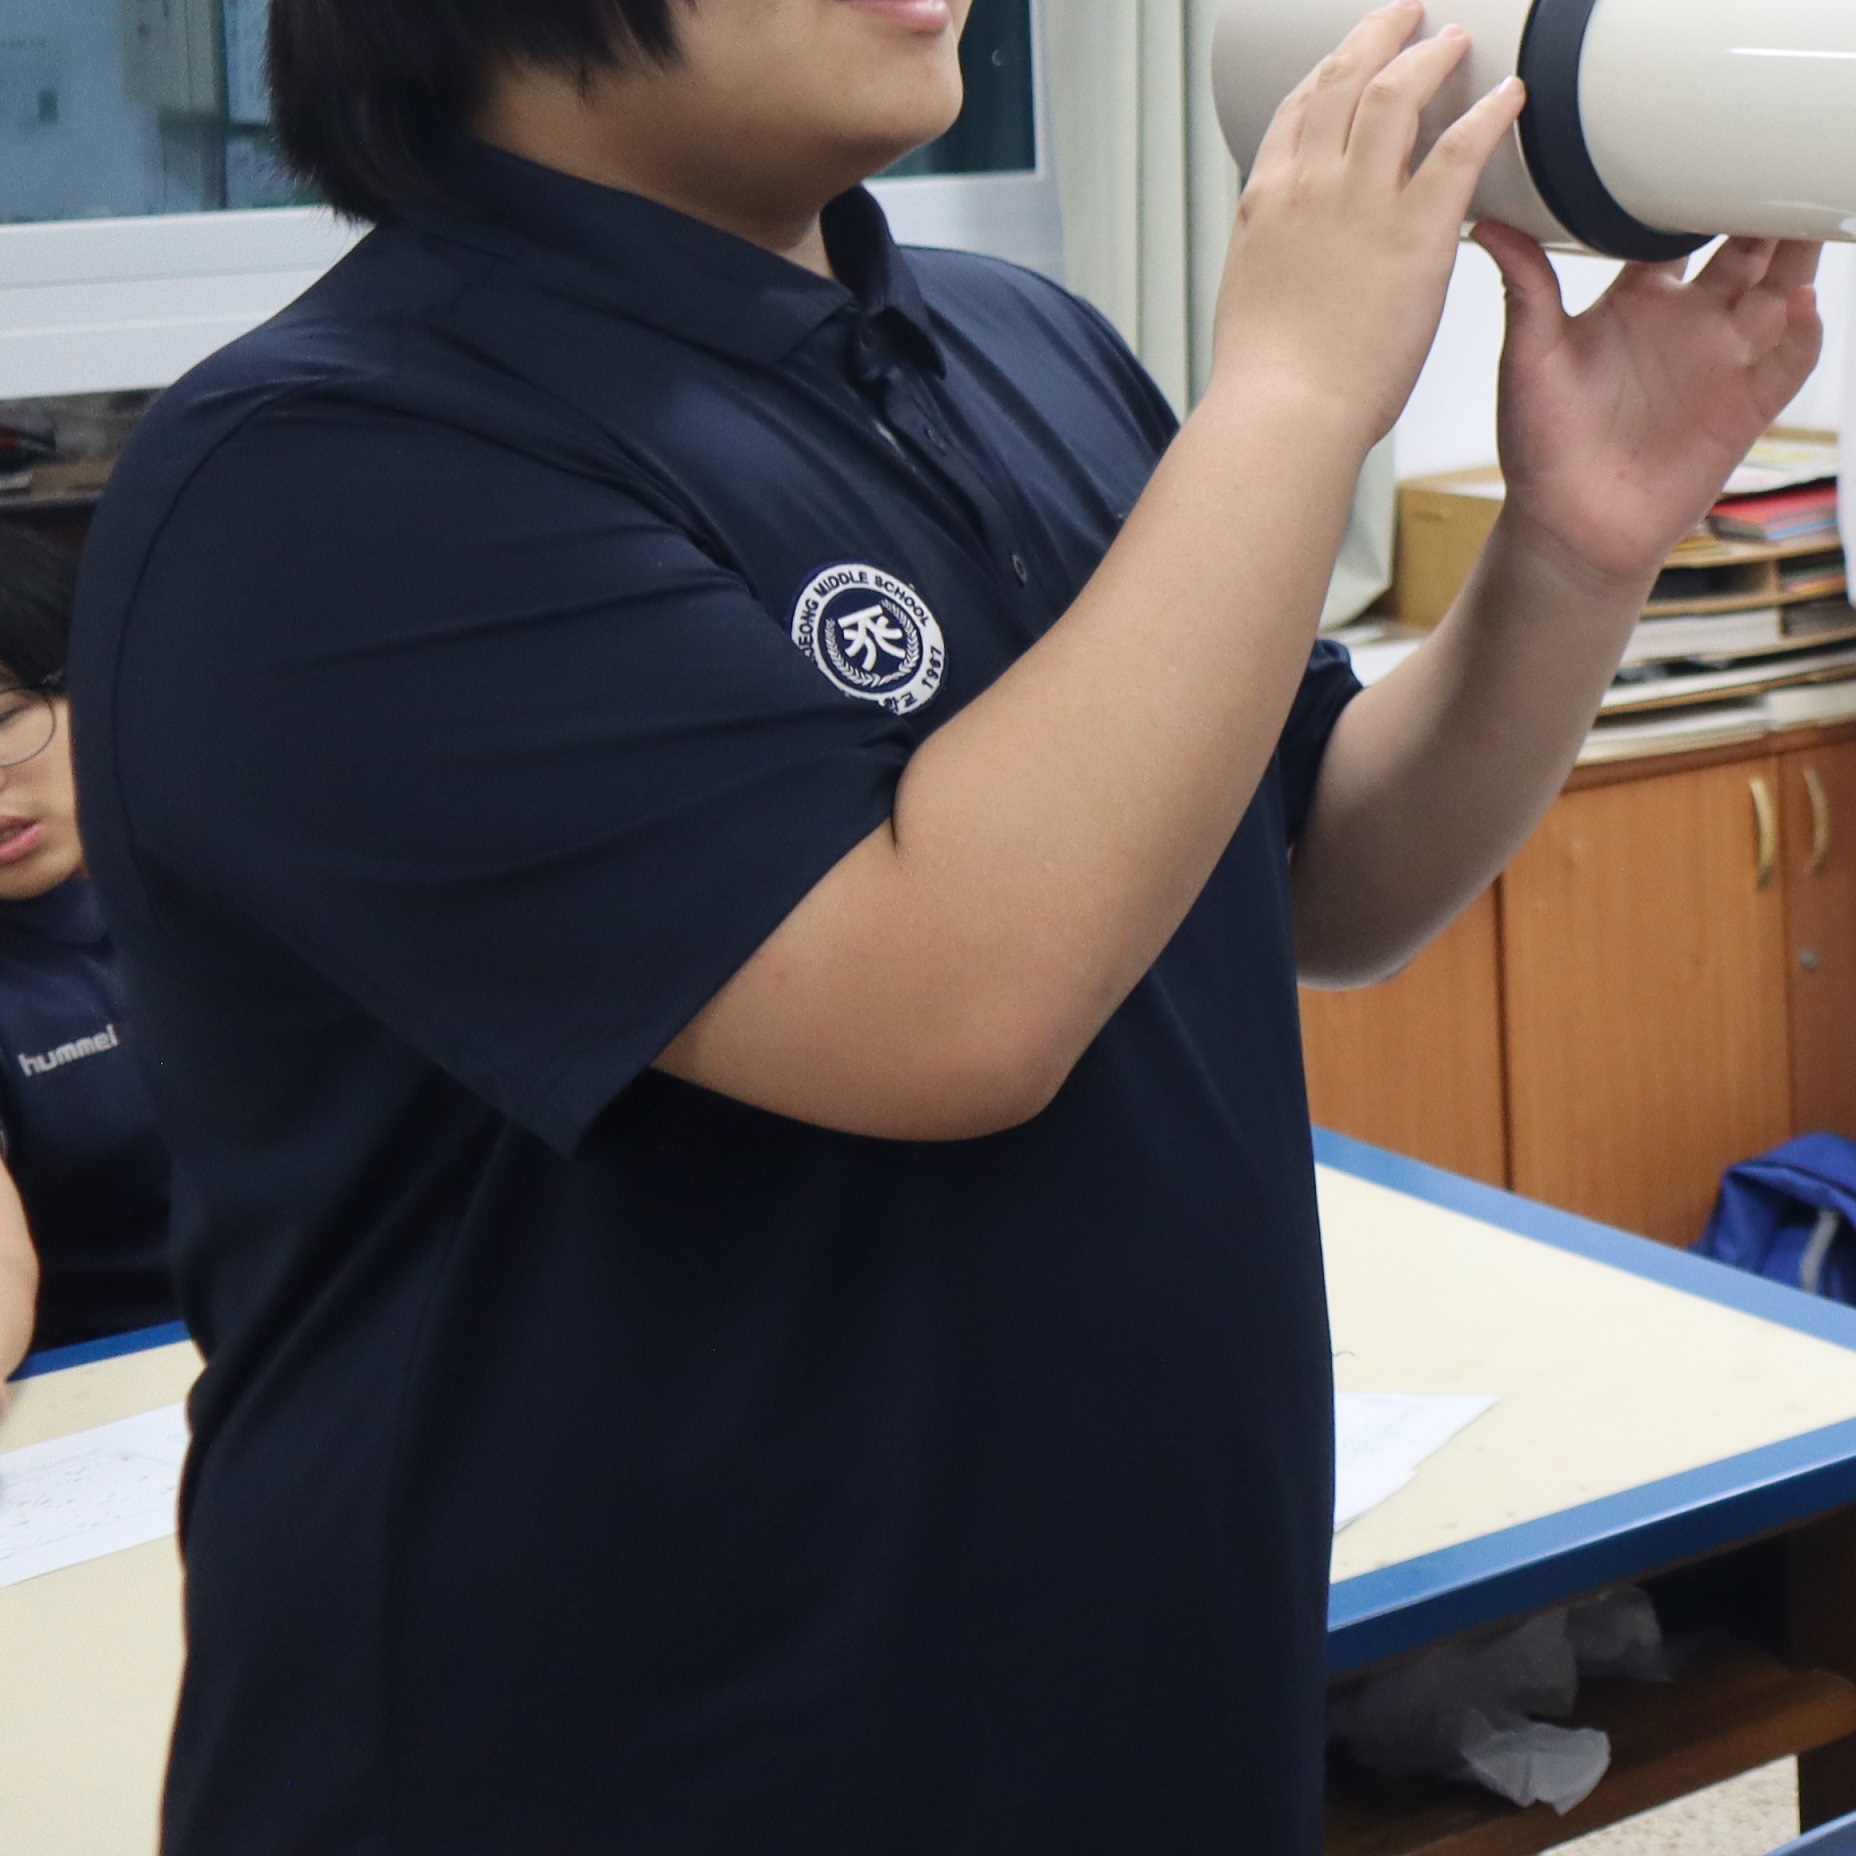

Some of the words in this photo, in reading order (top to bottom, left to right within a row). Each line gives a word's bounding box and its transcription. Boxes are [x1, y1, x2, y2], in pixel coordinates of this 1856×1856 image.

[814, 571, 869, 598] MIDDLE
[874, 575, 931, 627] SCHOOL
[17, 1024, 119, 1077] hummel
